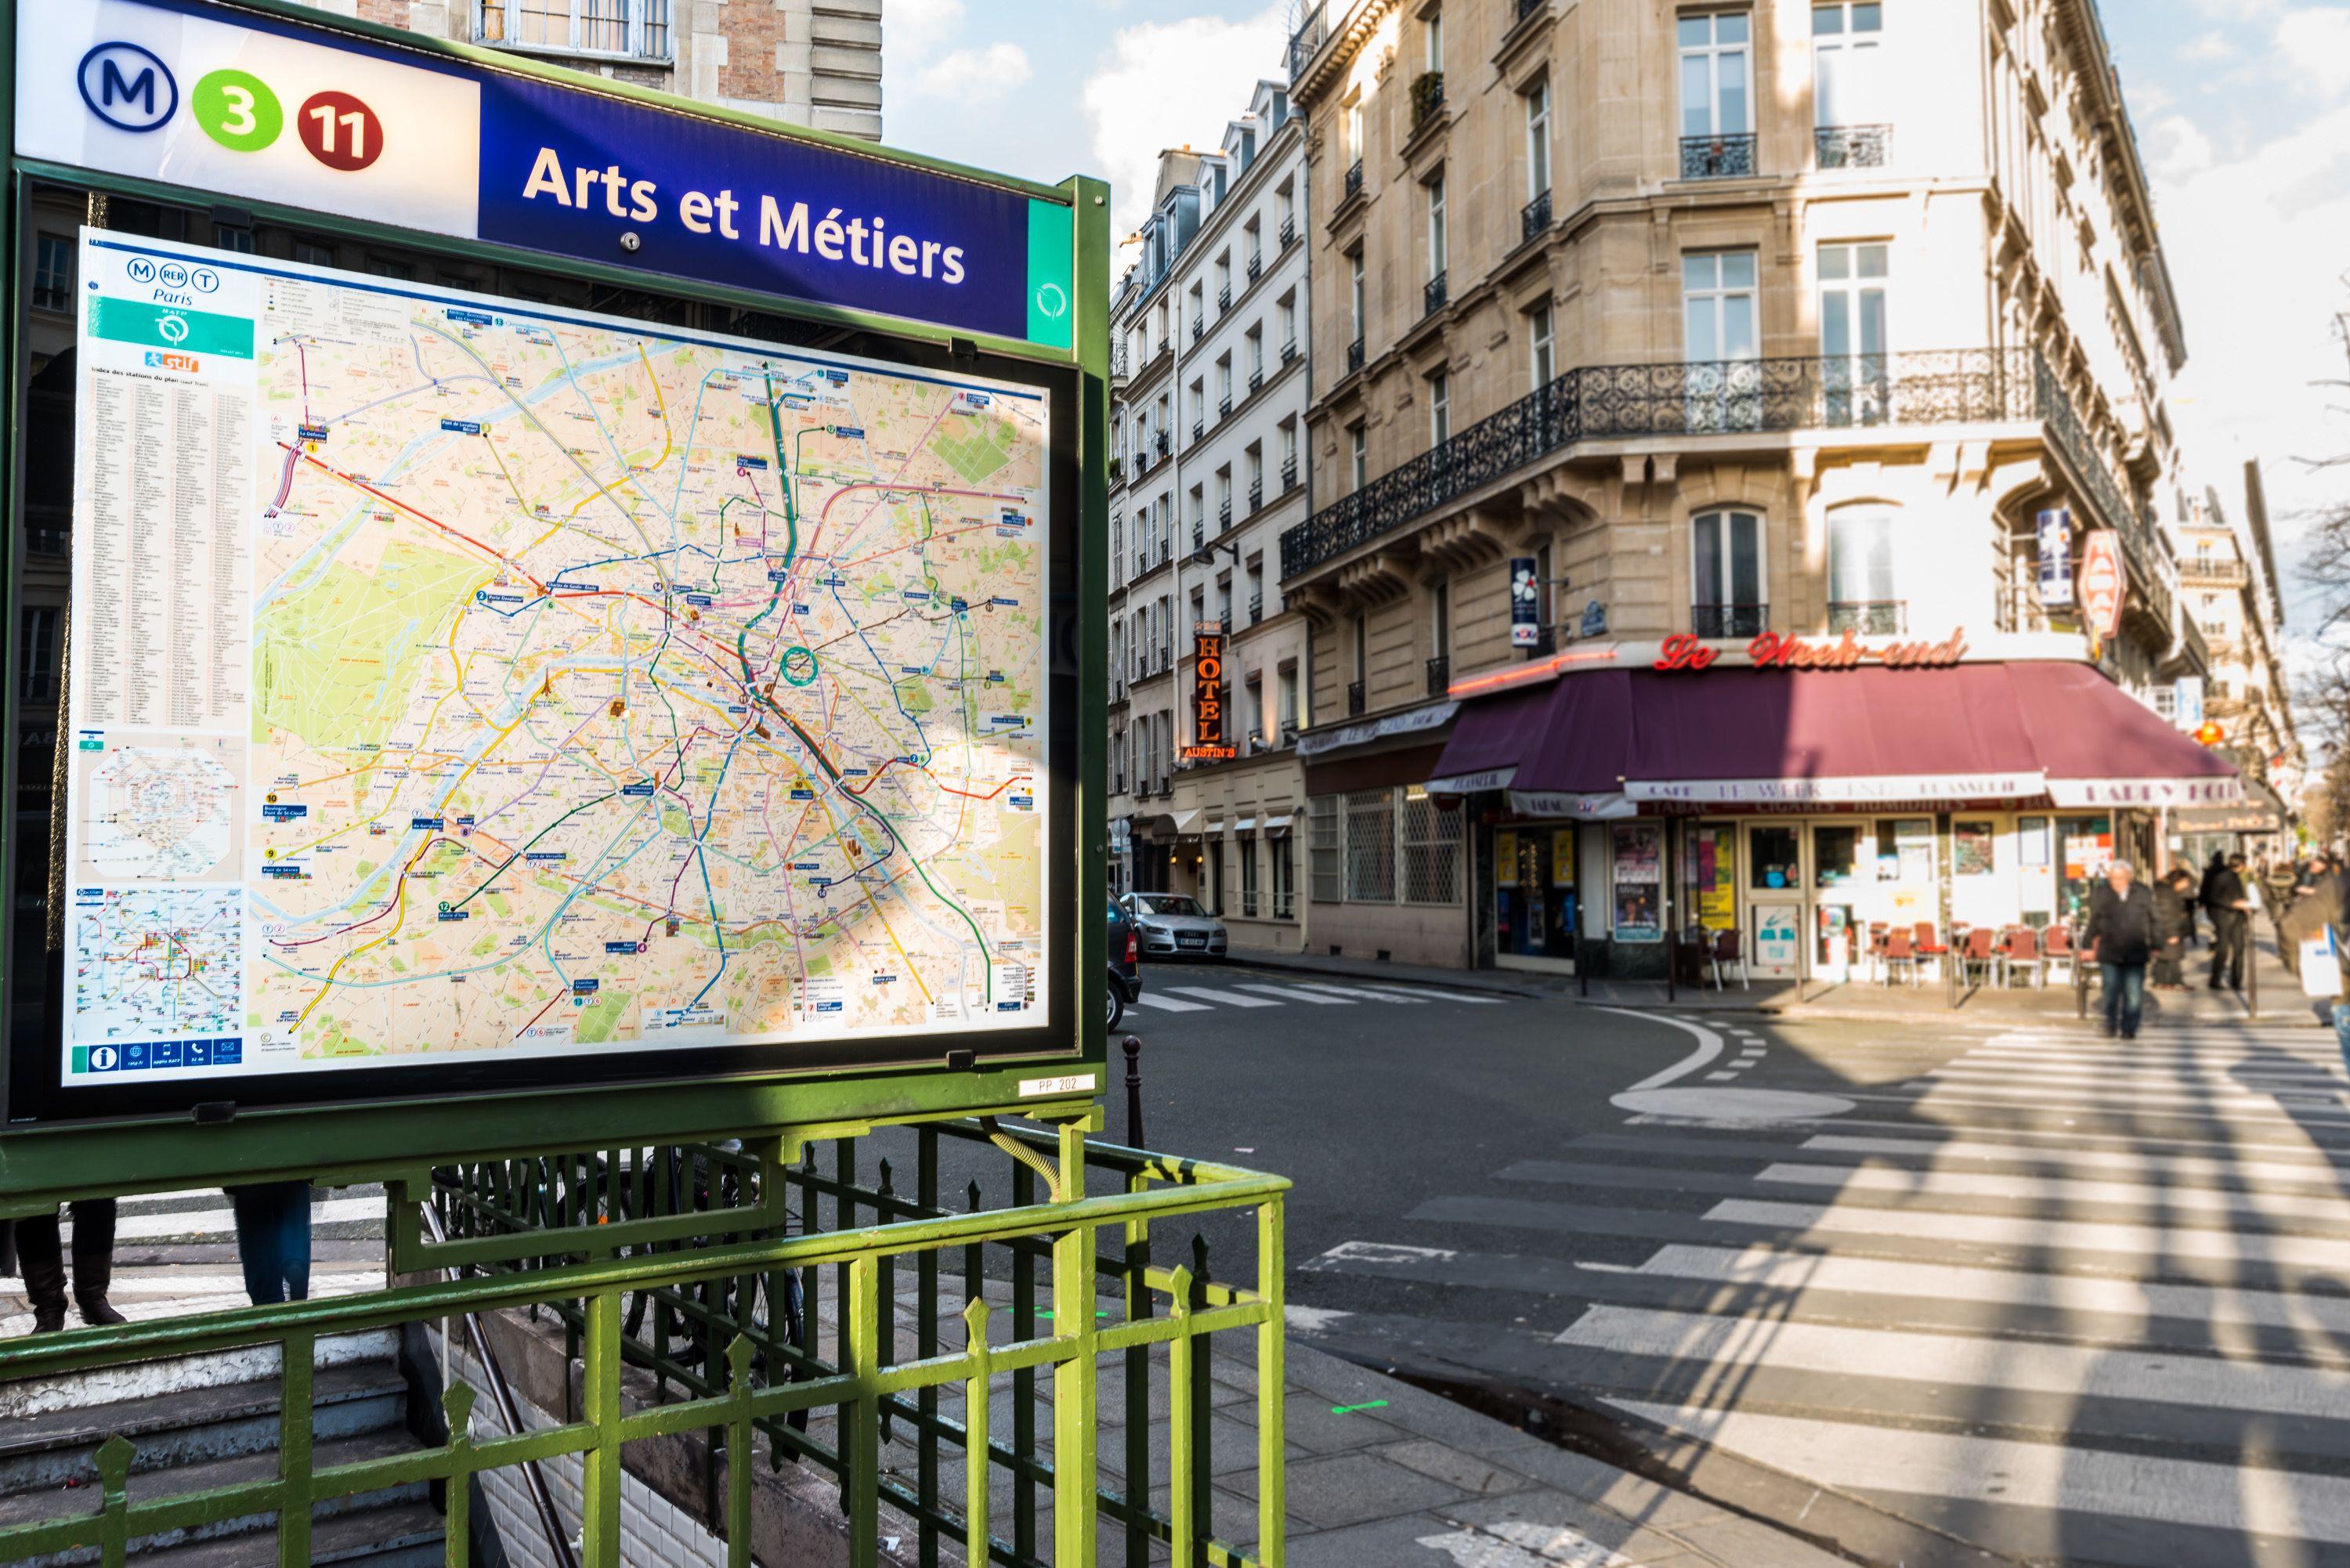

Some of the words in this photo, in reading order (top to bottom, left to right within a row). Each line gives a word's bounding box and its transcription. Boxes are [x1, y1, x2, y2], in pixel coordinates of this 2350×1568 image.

[103, 59, 154, 116] M
[221, 85, 256, 135] 3
[310, 104, 366, 159] 11
[522, 147, 657, 222] Arts
[679, 189, 739, 239] et
[759, 194, 965, 285] Métiers
[134, 263, 149, 277] M
[164, 271, 183, 281] RER
[199, 275, 211, 287] T
[154, 288, 193, 305] Paris
[167, 355, 195, 371] stif
[1654, 633, 1720, 671] Le
[1748, 626, 1969, 668] Week-end
[1197, 637, 1221, 742] HOTEL
[1183, 746, 1235, 759] AUSTIN'S
[1039, 1081, 1053, 1092] PP
[1059, 1077, 1077, 1091] 202
